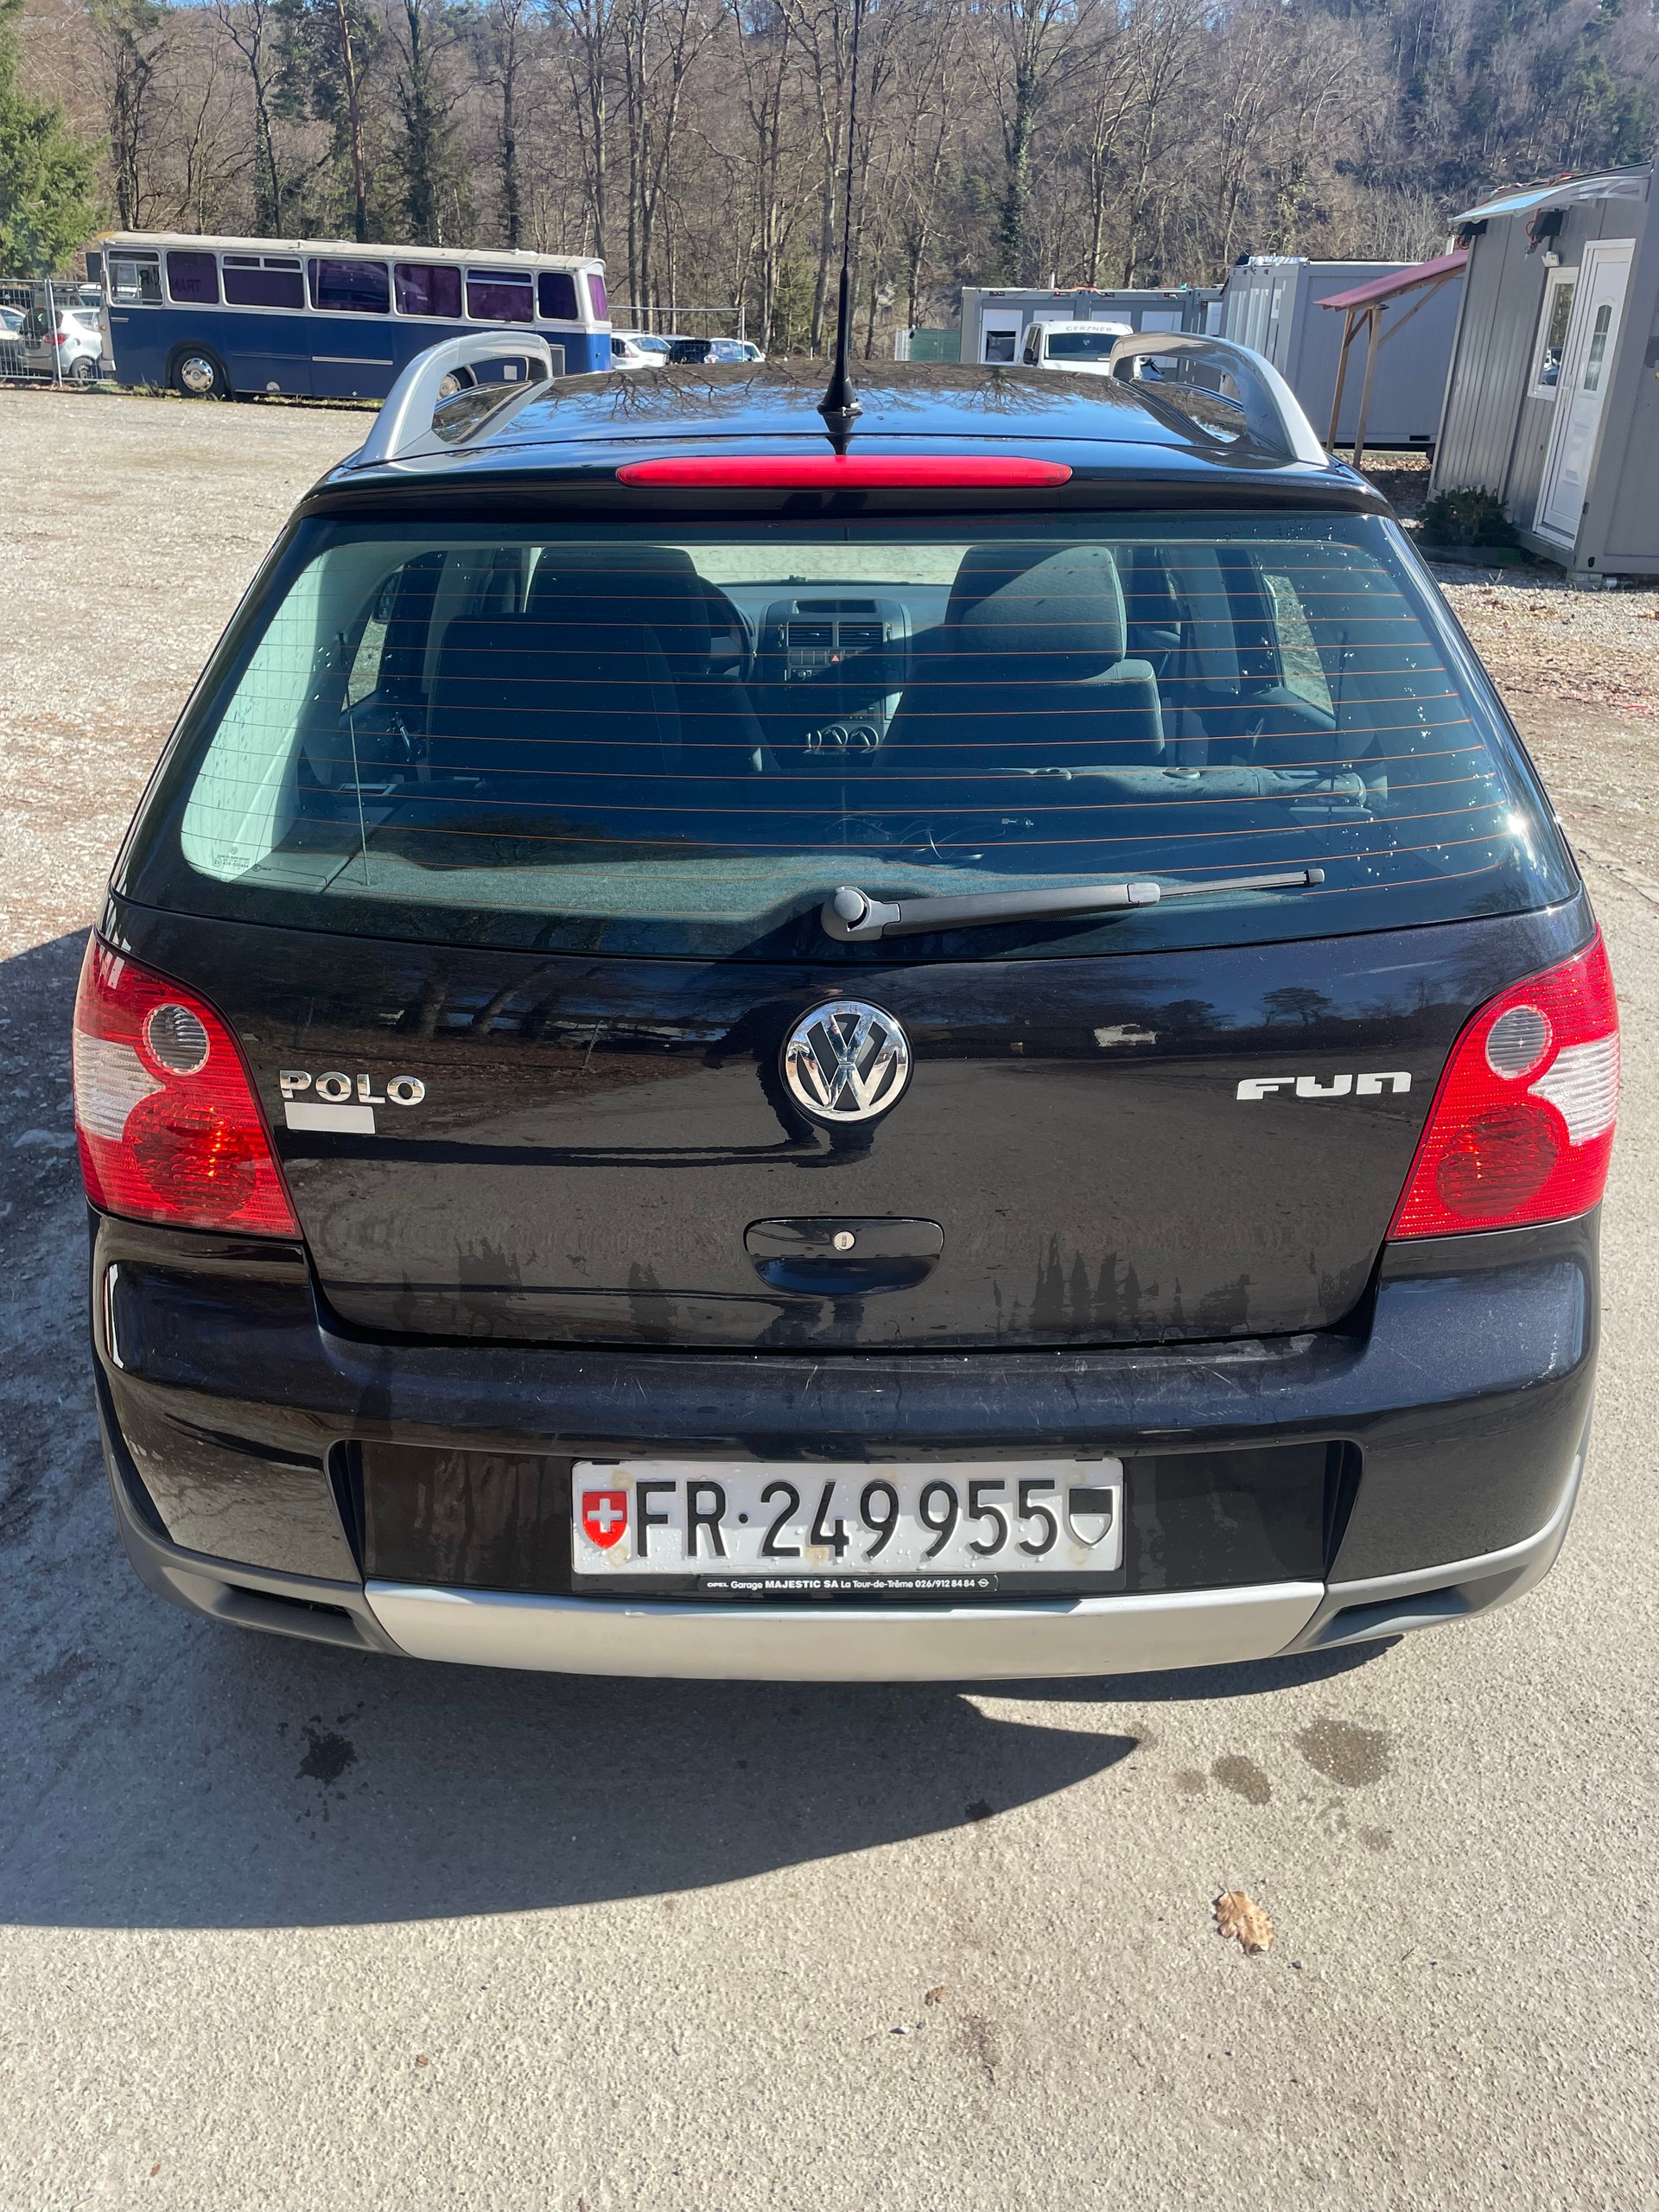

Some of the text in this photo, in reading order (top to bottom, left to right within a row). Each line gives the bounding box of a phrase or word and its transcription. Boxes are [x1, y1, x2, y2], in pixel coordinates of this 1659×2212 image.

[279, 1070, 426, 1106] POLO
[730, 1580, 763, 1591] Garage
[765, 1580, 821, 1589] MAJESTIC
[823, 1580, 839, 1588] SA
[841, 1580, 852, 1588] La
